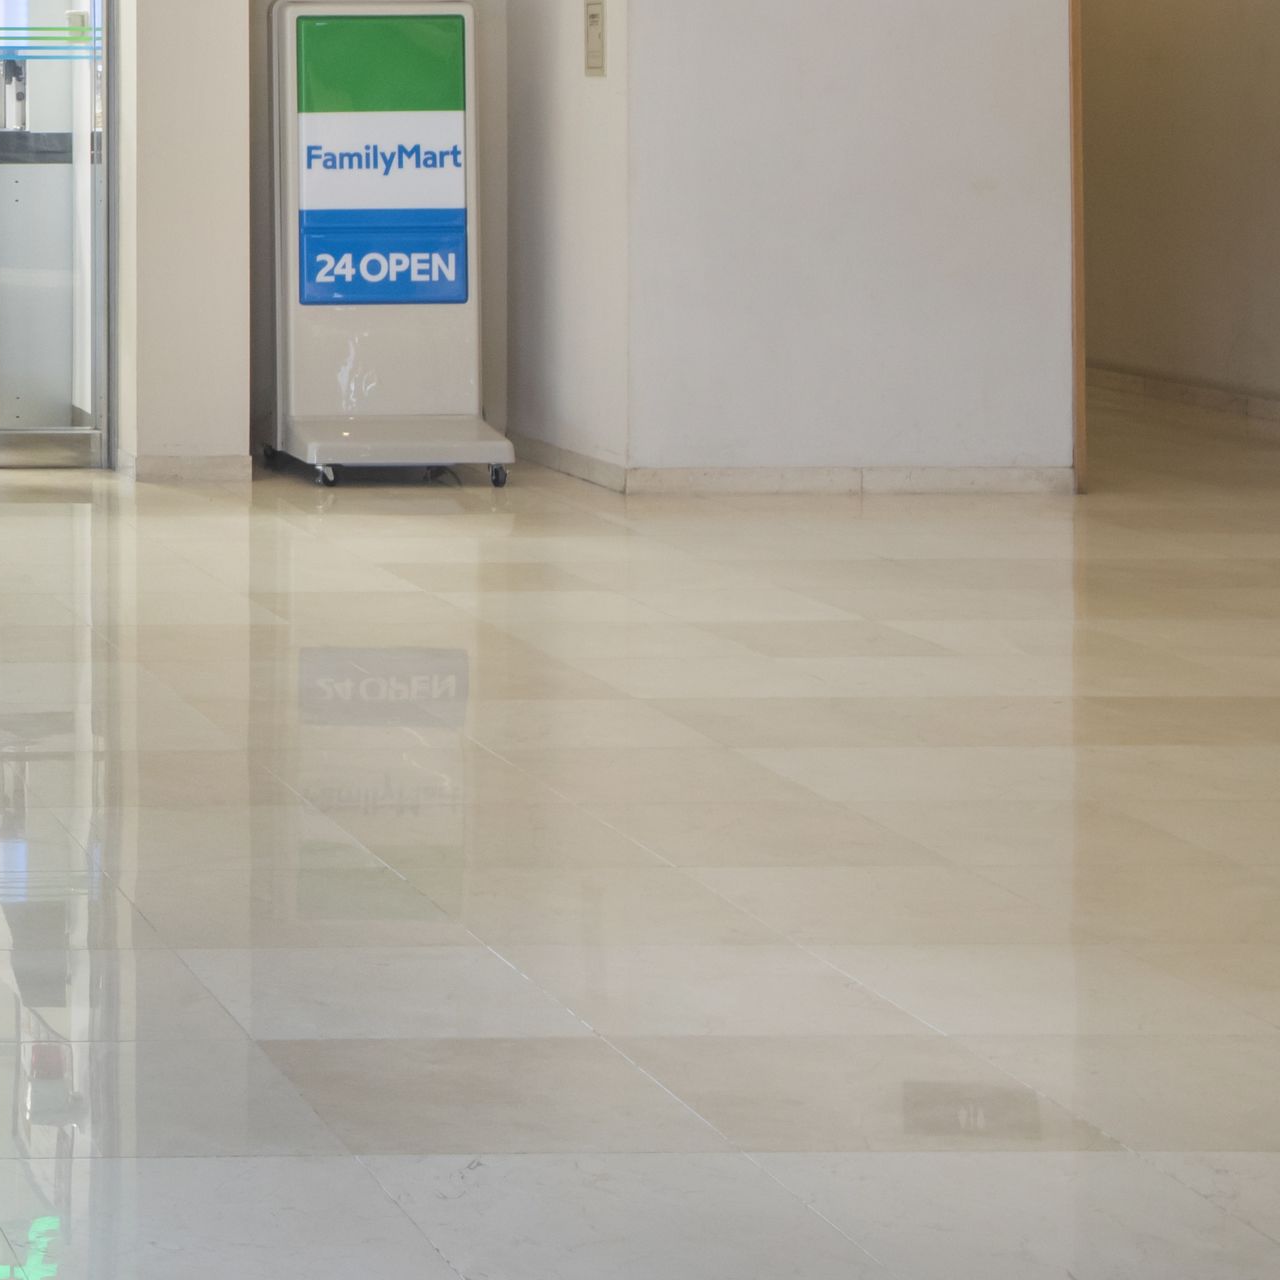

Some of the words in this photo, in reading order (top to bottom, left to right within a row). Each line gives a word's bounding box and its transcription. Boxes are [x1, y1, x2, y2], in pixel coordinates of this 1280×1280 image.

[306, 144, 462, 176] FamilyMart
[316, 253, 356, 283] 24
[359, 252, 456, 282] OPEN
